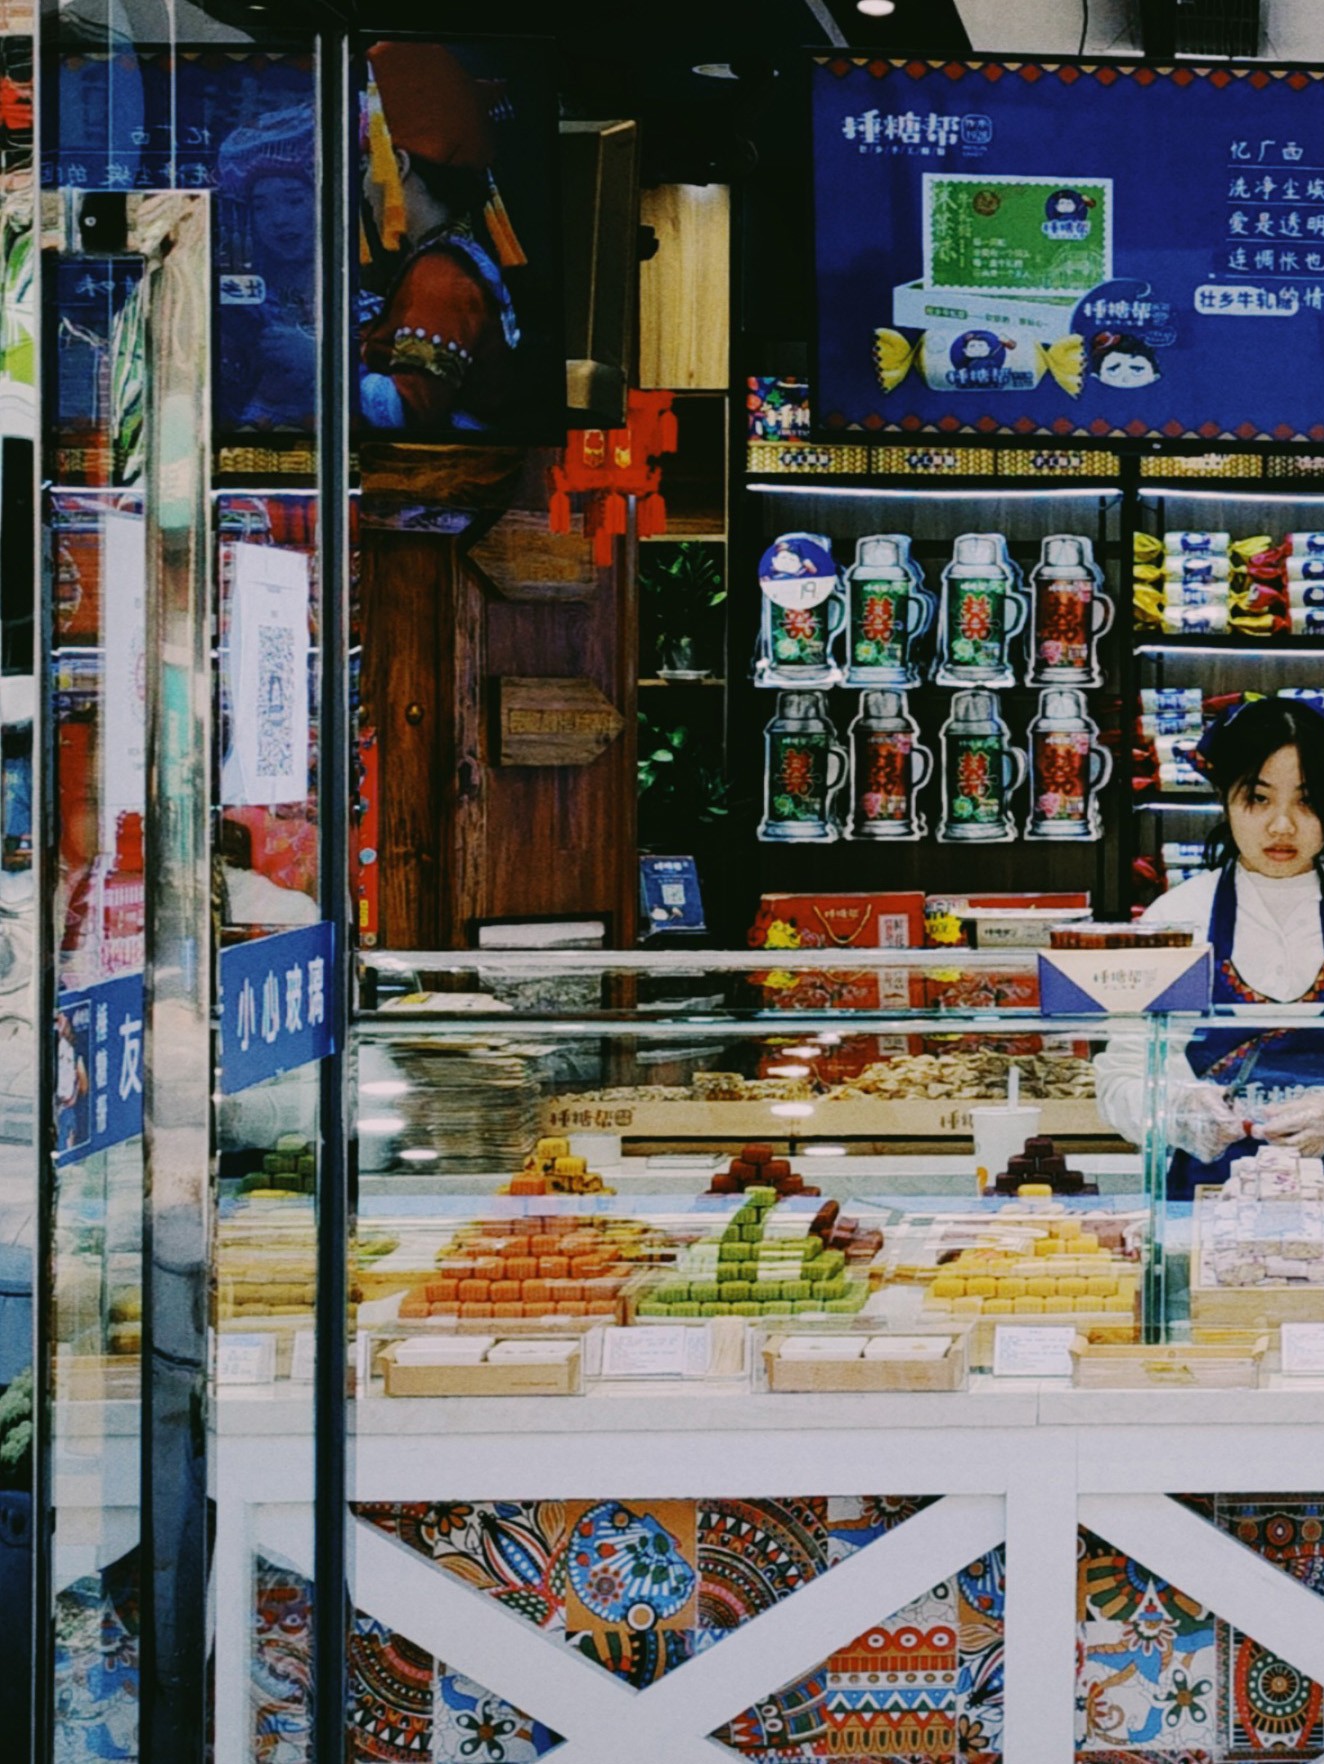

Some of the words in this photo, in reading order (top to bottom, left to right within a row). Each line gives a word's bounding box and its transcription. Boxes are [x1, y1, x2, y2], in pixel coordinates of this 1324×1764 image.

[1230, 140, 1304, 162] 忆广西
[236, 956, 325, 1053] 小心玻璃
